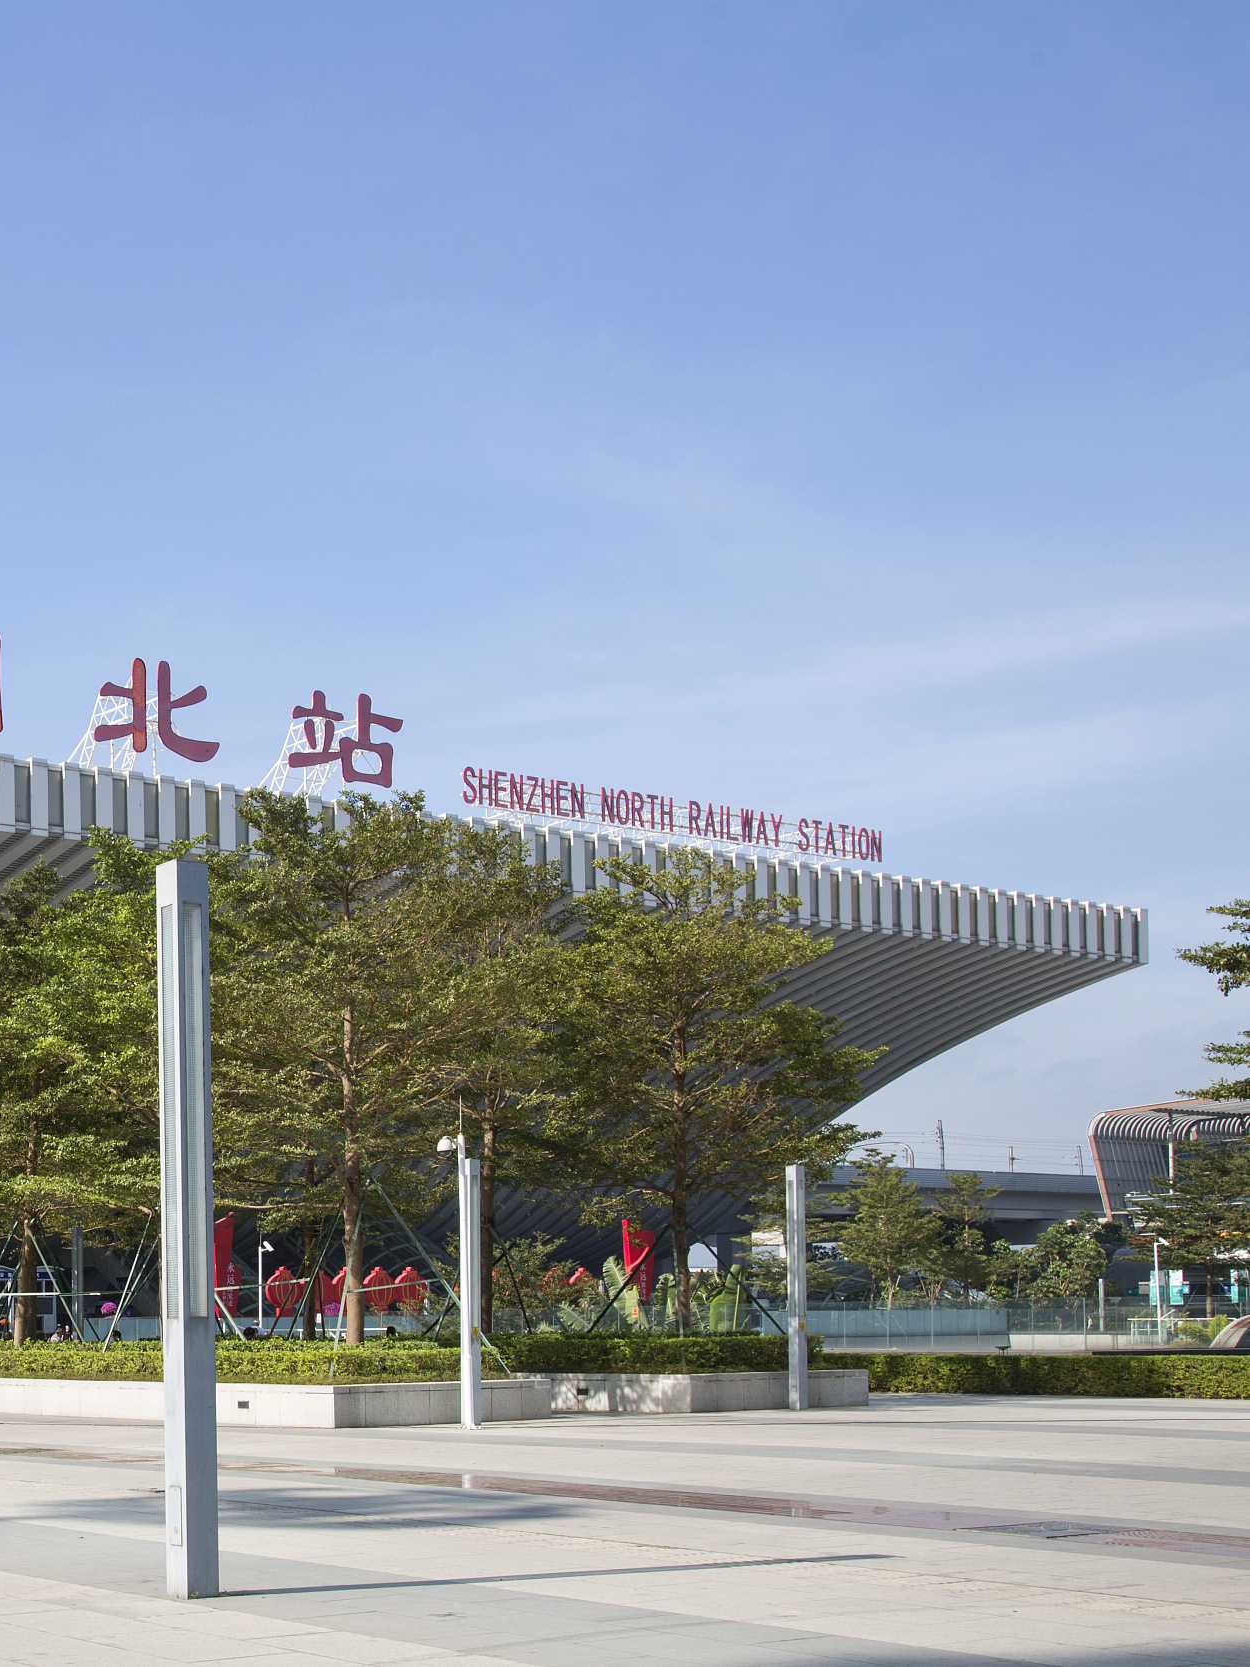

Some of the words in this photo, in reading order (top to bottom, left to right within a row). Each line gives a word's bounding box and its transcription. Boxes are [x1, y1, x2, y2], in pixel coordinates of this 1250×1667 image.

[462, 766, 585, 820] SHENZHEN
[600, 786, 674, 833] NORTH
[688, 800, 783, 848] RAILWAY
[797, 817, 883, 863] STATION
